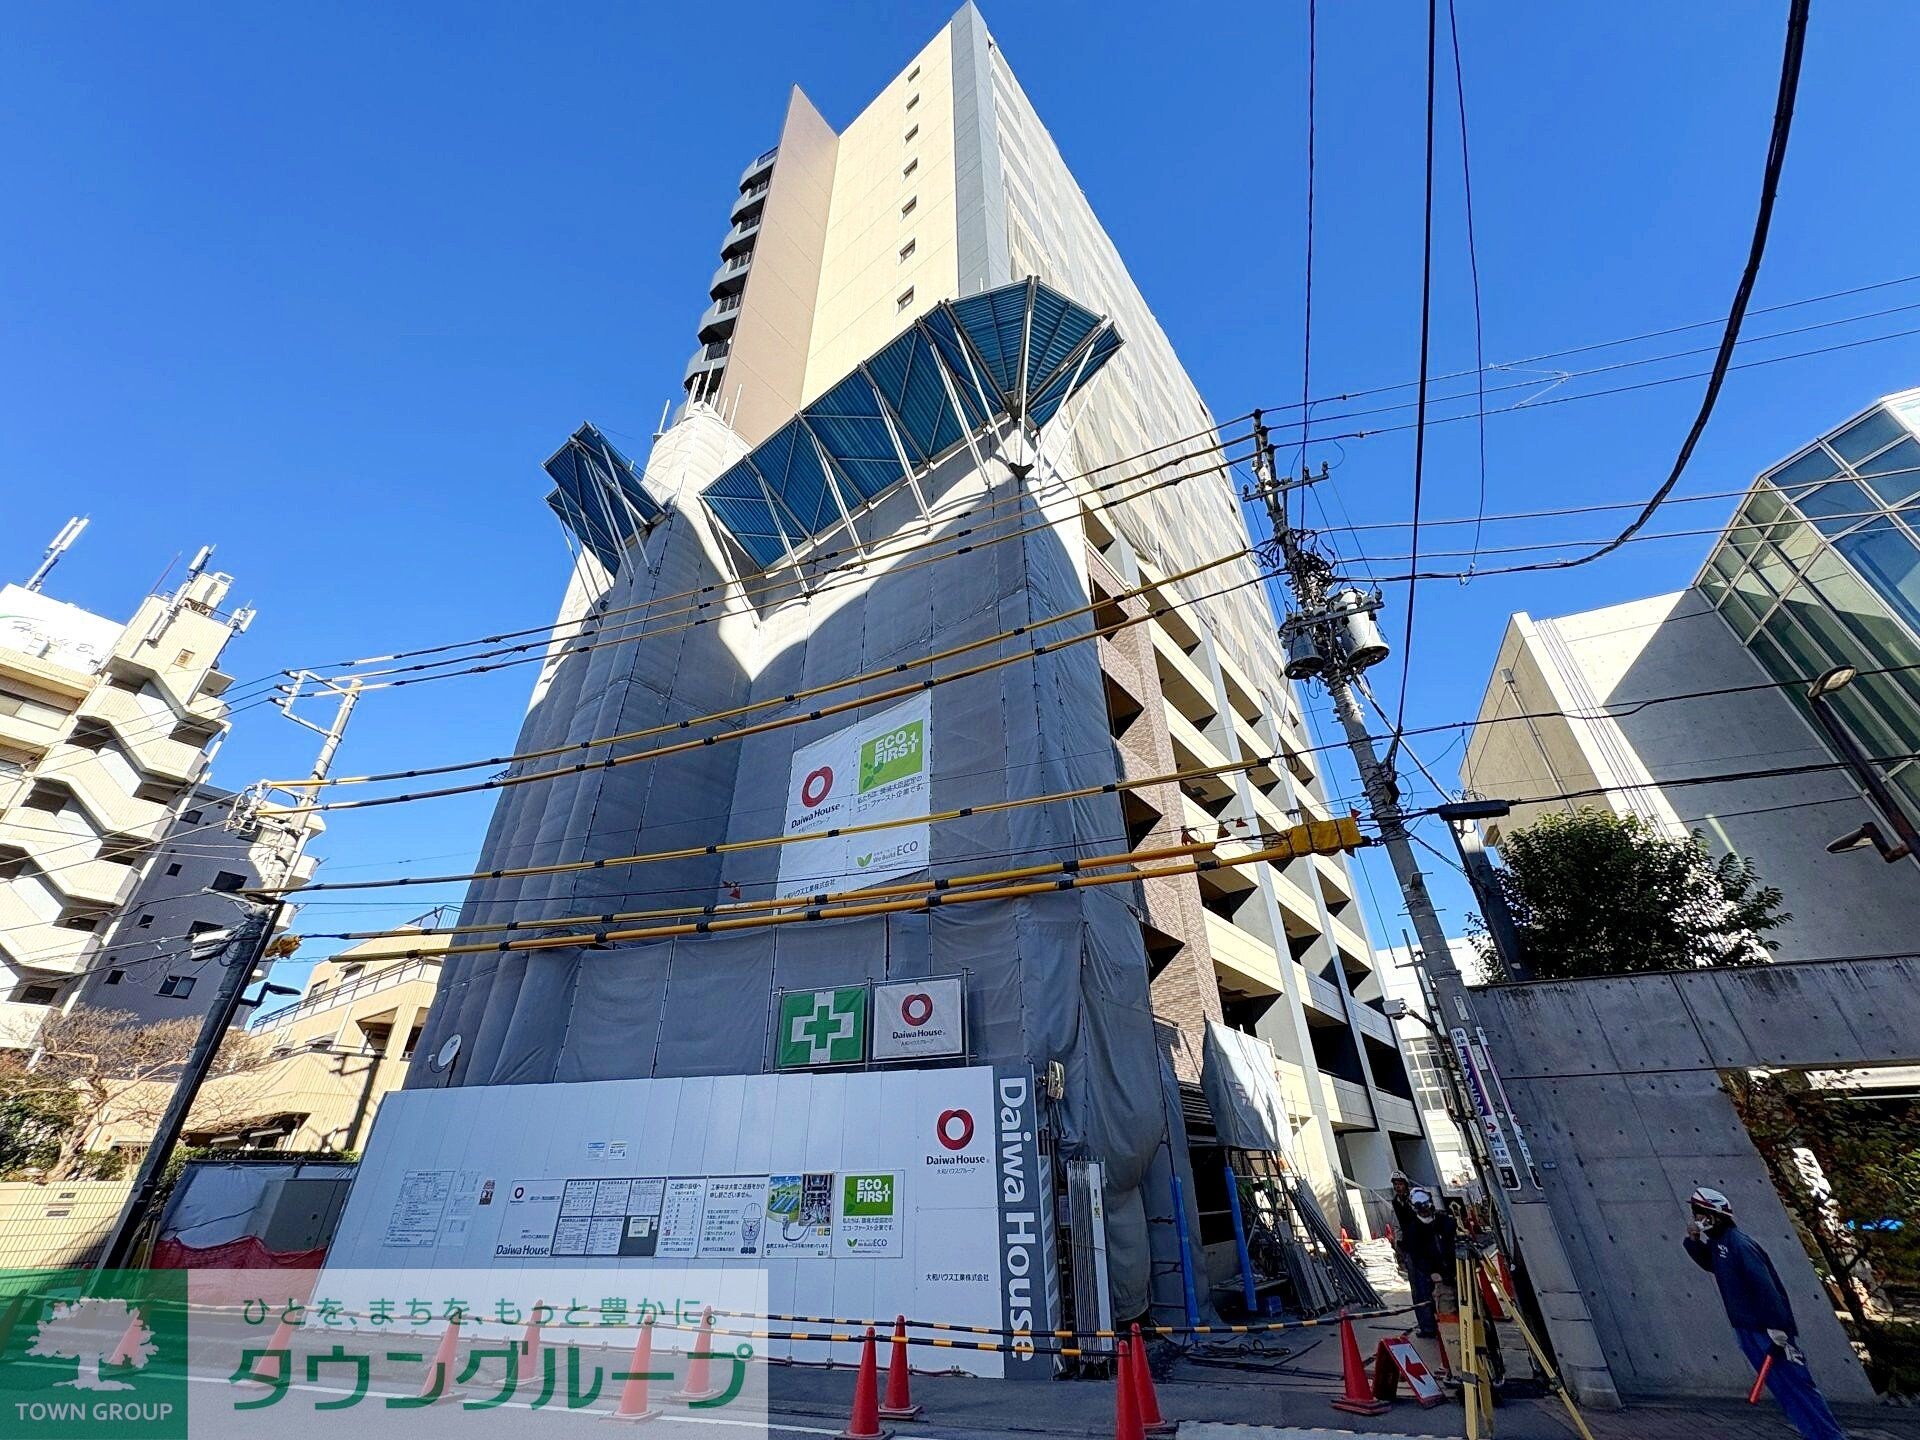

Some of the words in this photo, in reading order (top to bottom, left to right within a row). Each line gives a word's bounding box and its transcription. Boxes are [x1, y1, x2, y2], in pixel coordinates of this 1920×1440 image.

[874, 731, 907, 753] ECO
[791, 813, 814, 829] Daiwa
[814, 803, 841, 818] House
[896, 840, 918, 856] ECO
[892, 1031, 916, 1039] Daiwa
[917, 1029, 943, 1037] House
[1000, 1077, 1031, 1203] Daiwa
[926, 1155, 955, 1165] Daiwa
[956, 1155, 986, 1164] House
[857, 1179, 882, 1190] ECO
[873, 1238, 887, 1247] ECO
[496, 1243, 522, 1255] Daiwa
[522, 1244, 550, 1255] House
[926, 1272, 990, 1282] 大和ハウス工業株式会社
[1005, 1212, 1036, 1362] House
